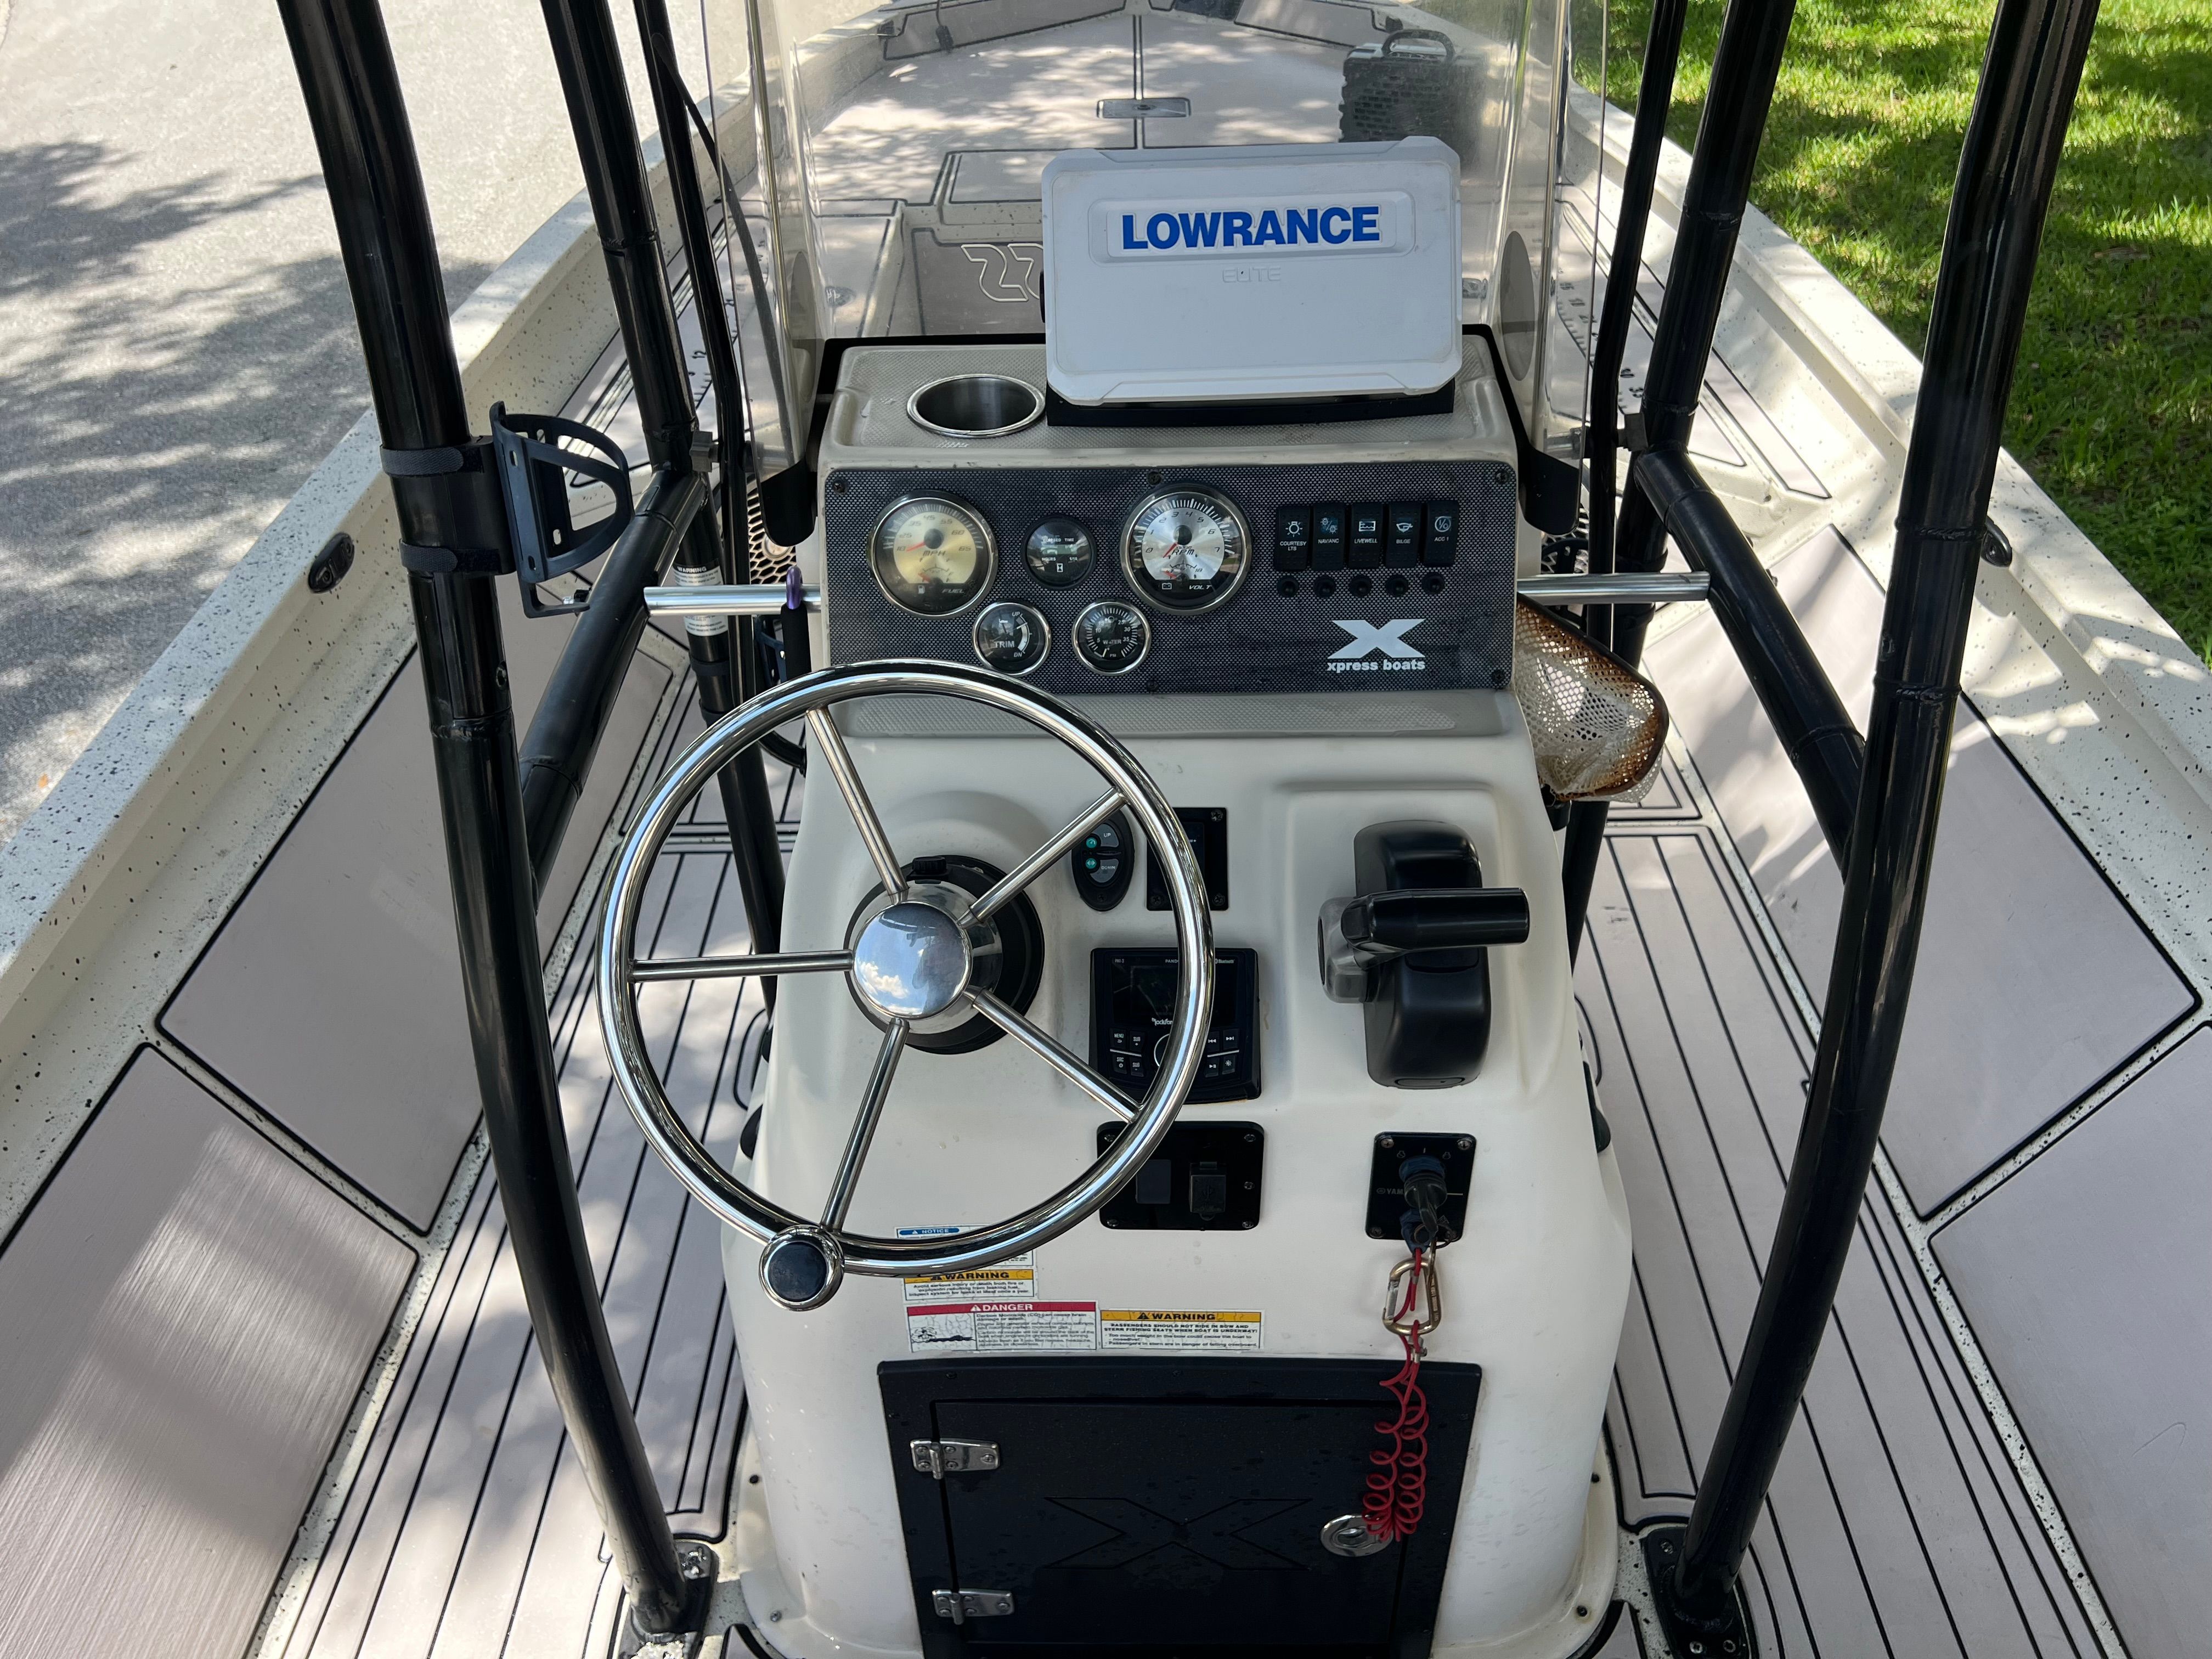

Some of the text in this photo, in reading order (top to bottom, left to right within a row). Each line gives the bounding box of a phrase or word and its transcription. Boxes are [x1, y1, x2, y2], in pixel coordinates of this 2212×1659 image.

[1122, 206, 1379, 250] LOWRANCE
[1223, 266, 1282, 283] ELITE
[1327, 659, 1426, 673] xpress boats
